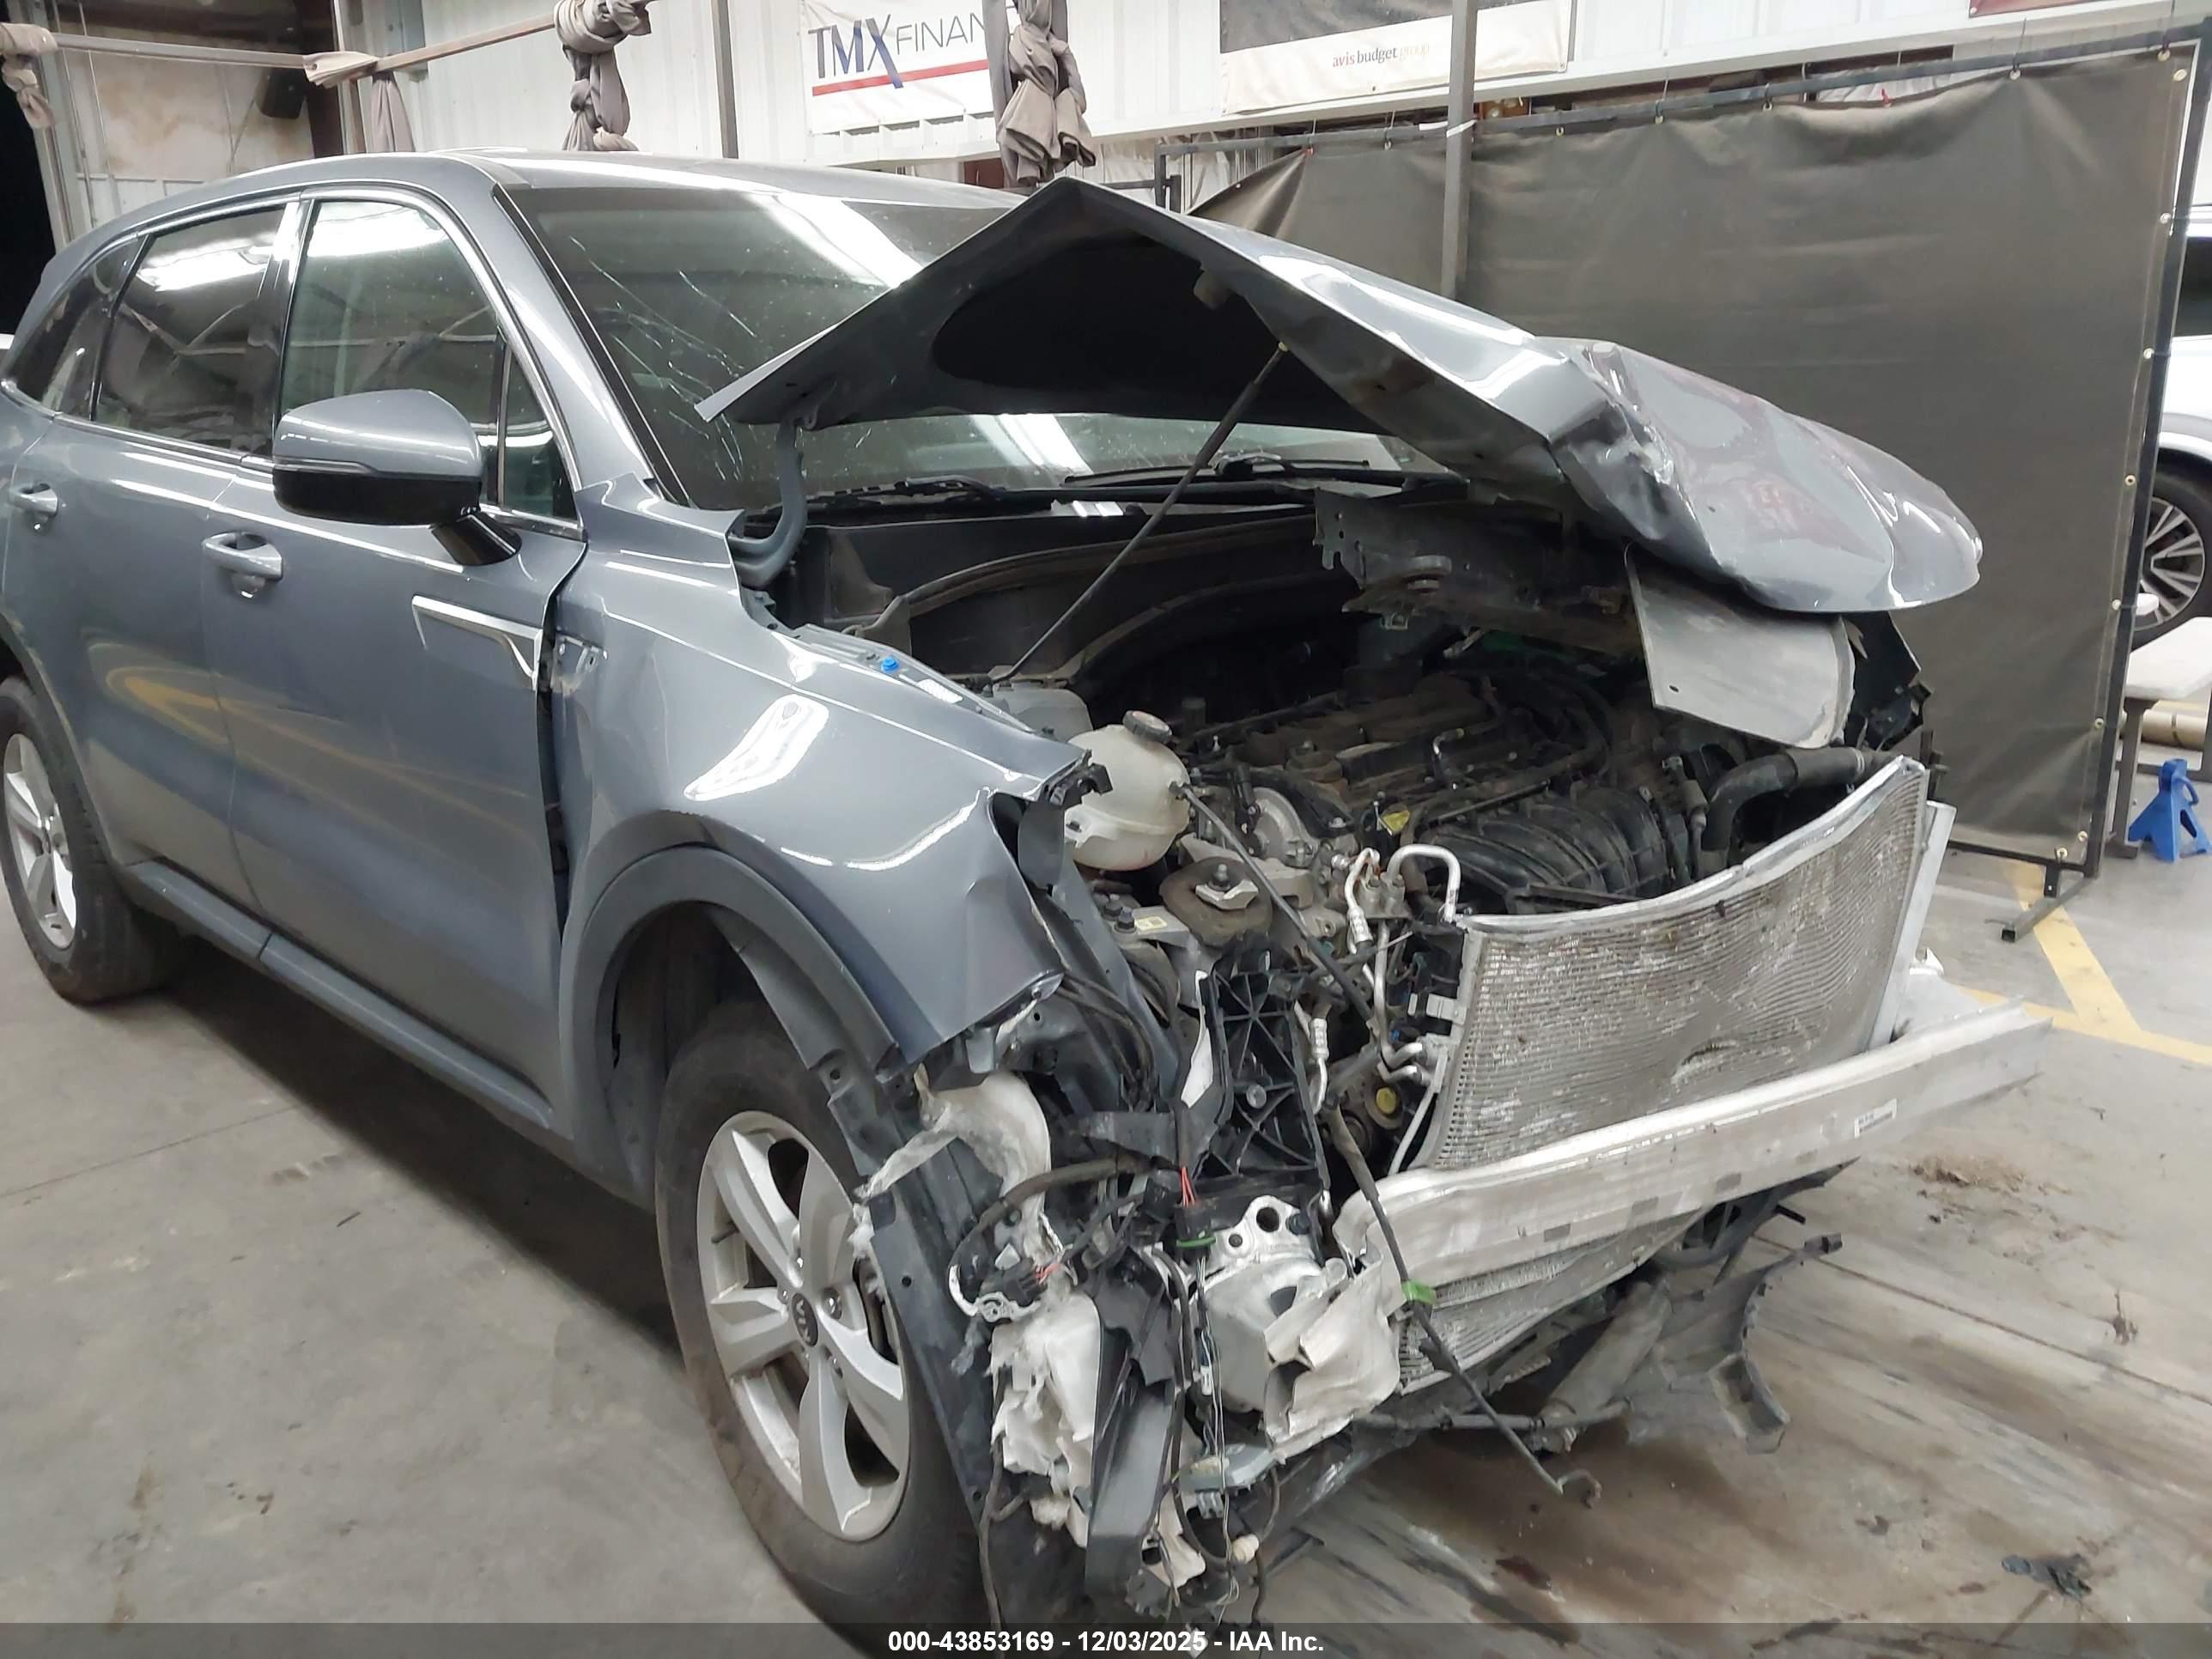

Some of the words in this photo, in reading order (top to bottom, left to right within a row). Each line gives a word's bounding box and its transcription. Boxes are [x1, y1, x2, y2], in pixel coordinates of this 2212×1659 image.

[808, 14, 904, 89] TMX
[896, 5, 1016, 56] FINAN
[1332, 52, 1356, 68] avis
[1357, 47, 1399, 64] budget
